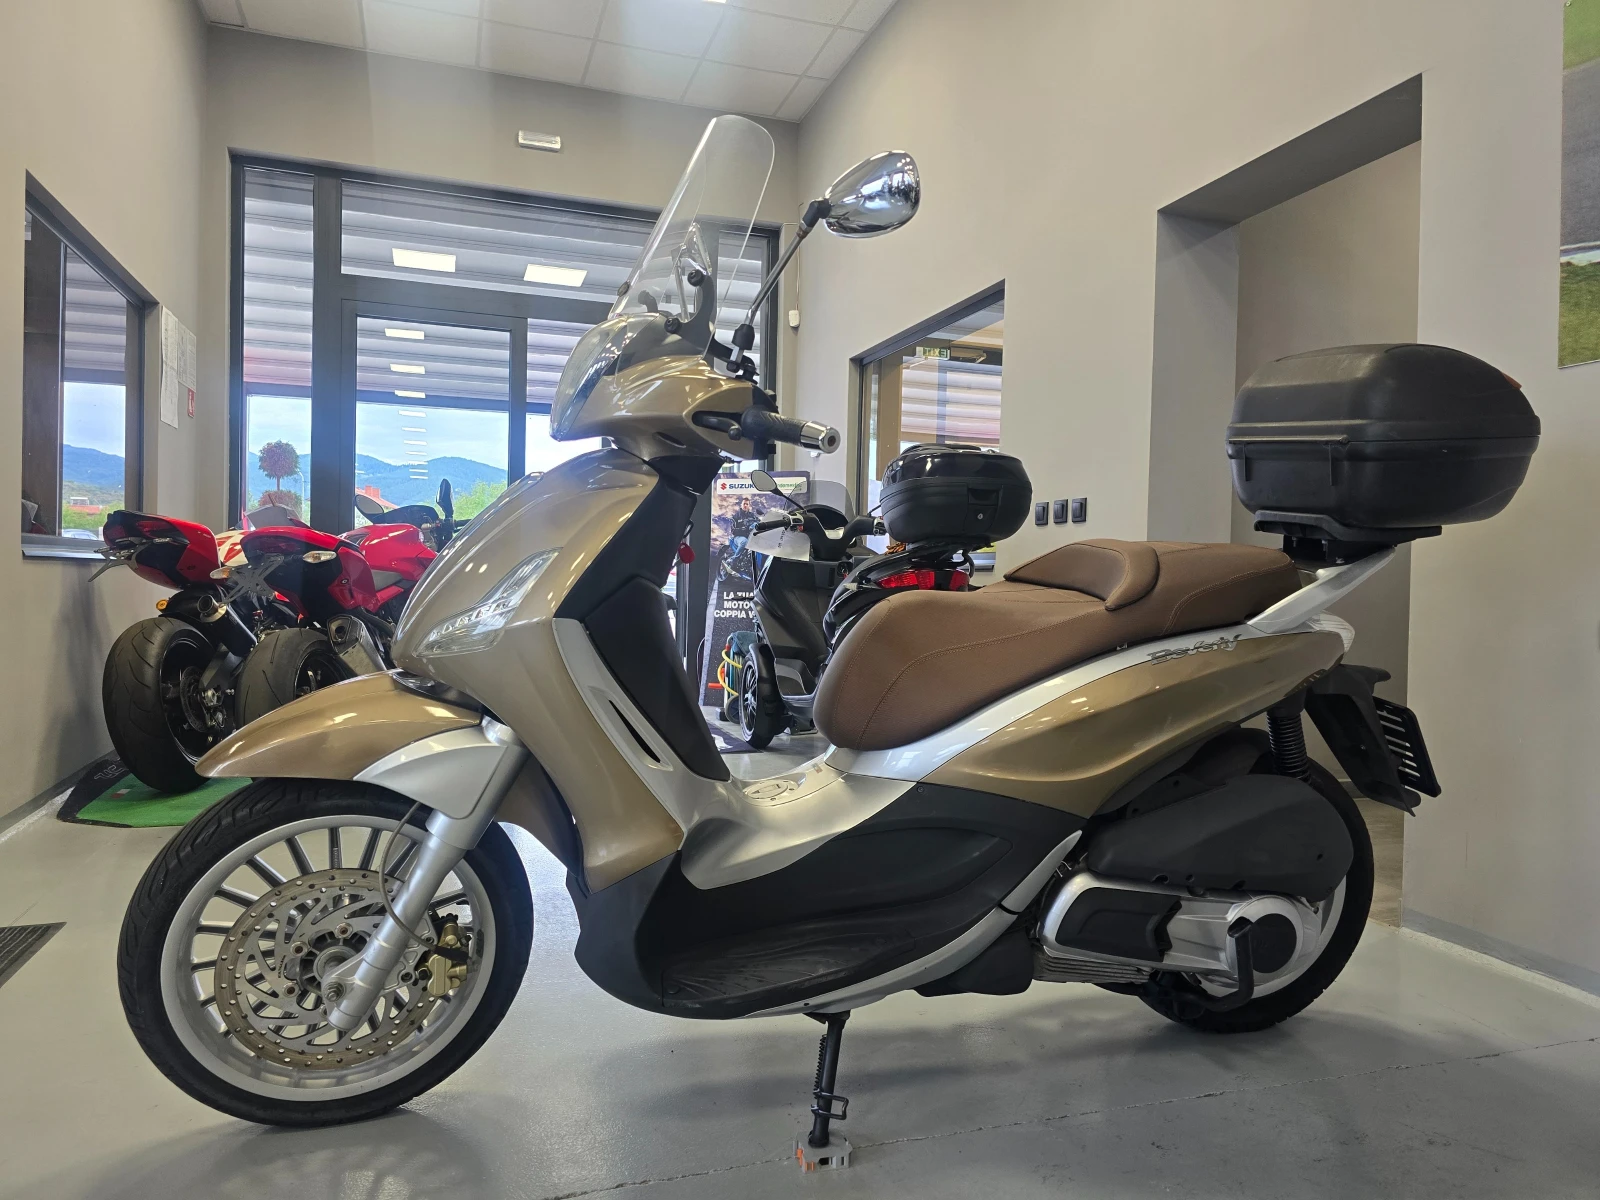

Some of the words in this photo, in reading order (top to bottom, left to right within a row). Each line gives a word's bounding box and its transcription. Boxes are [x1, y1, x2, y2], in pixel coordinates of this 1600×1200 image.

[723, 591, 734, 600] LA
[723, 600, 750, 609] MOTO
[713, 609, 747, 618] COPPIA
